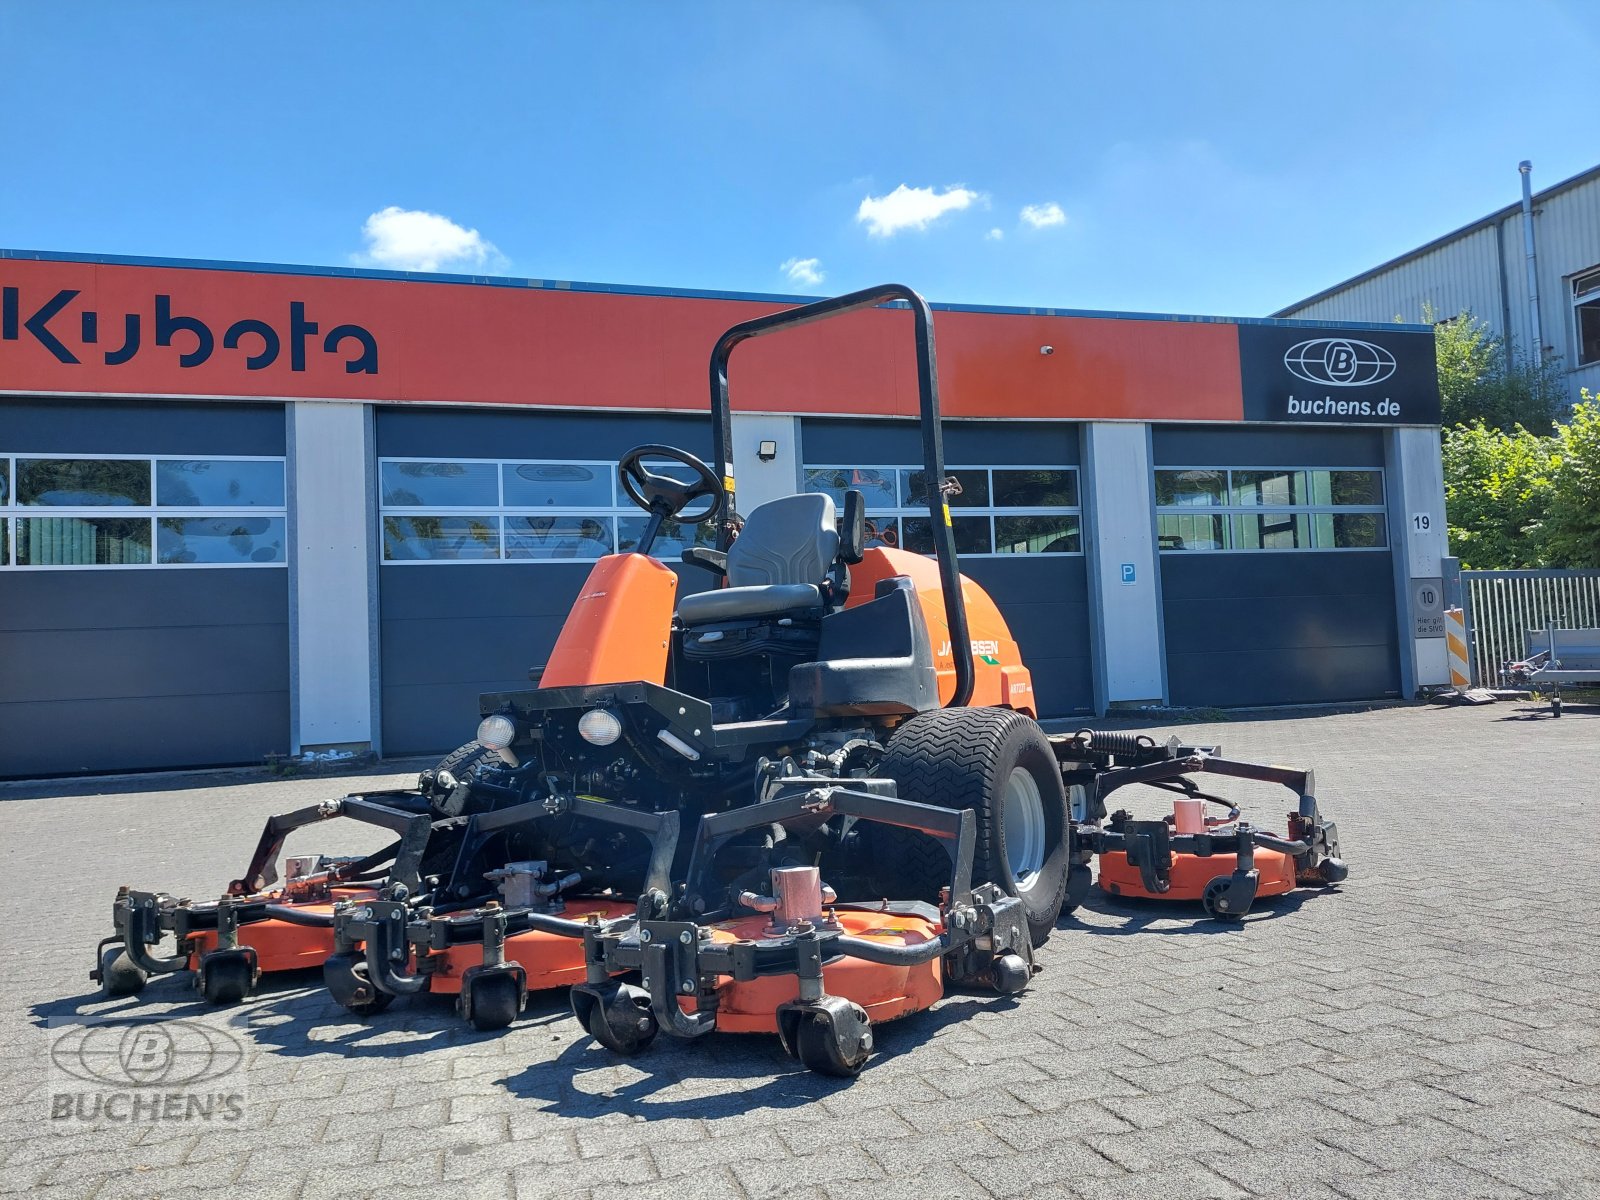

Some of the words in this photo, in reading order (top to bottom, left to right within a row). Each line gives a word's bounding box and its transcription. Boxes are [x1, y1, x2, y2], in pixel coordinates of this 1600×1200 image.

[2, 286, 378, 374] Kubota
[1287, 395, 1401, 416] buchens.de
[1414, 515, 1430, 529] 19
[1123, 565, 1133, 580] P
[1422, 591, 1434, 604] 10
[1417, 616, 1430, 624] Hier
[1417, 625, 1427, 633] die
[937, 640, 999, 656] JABSEN
